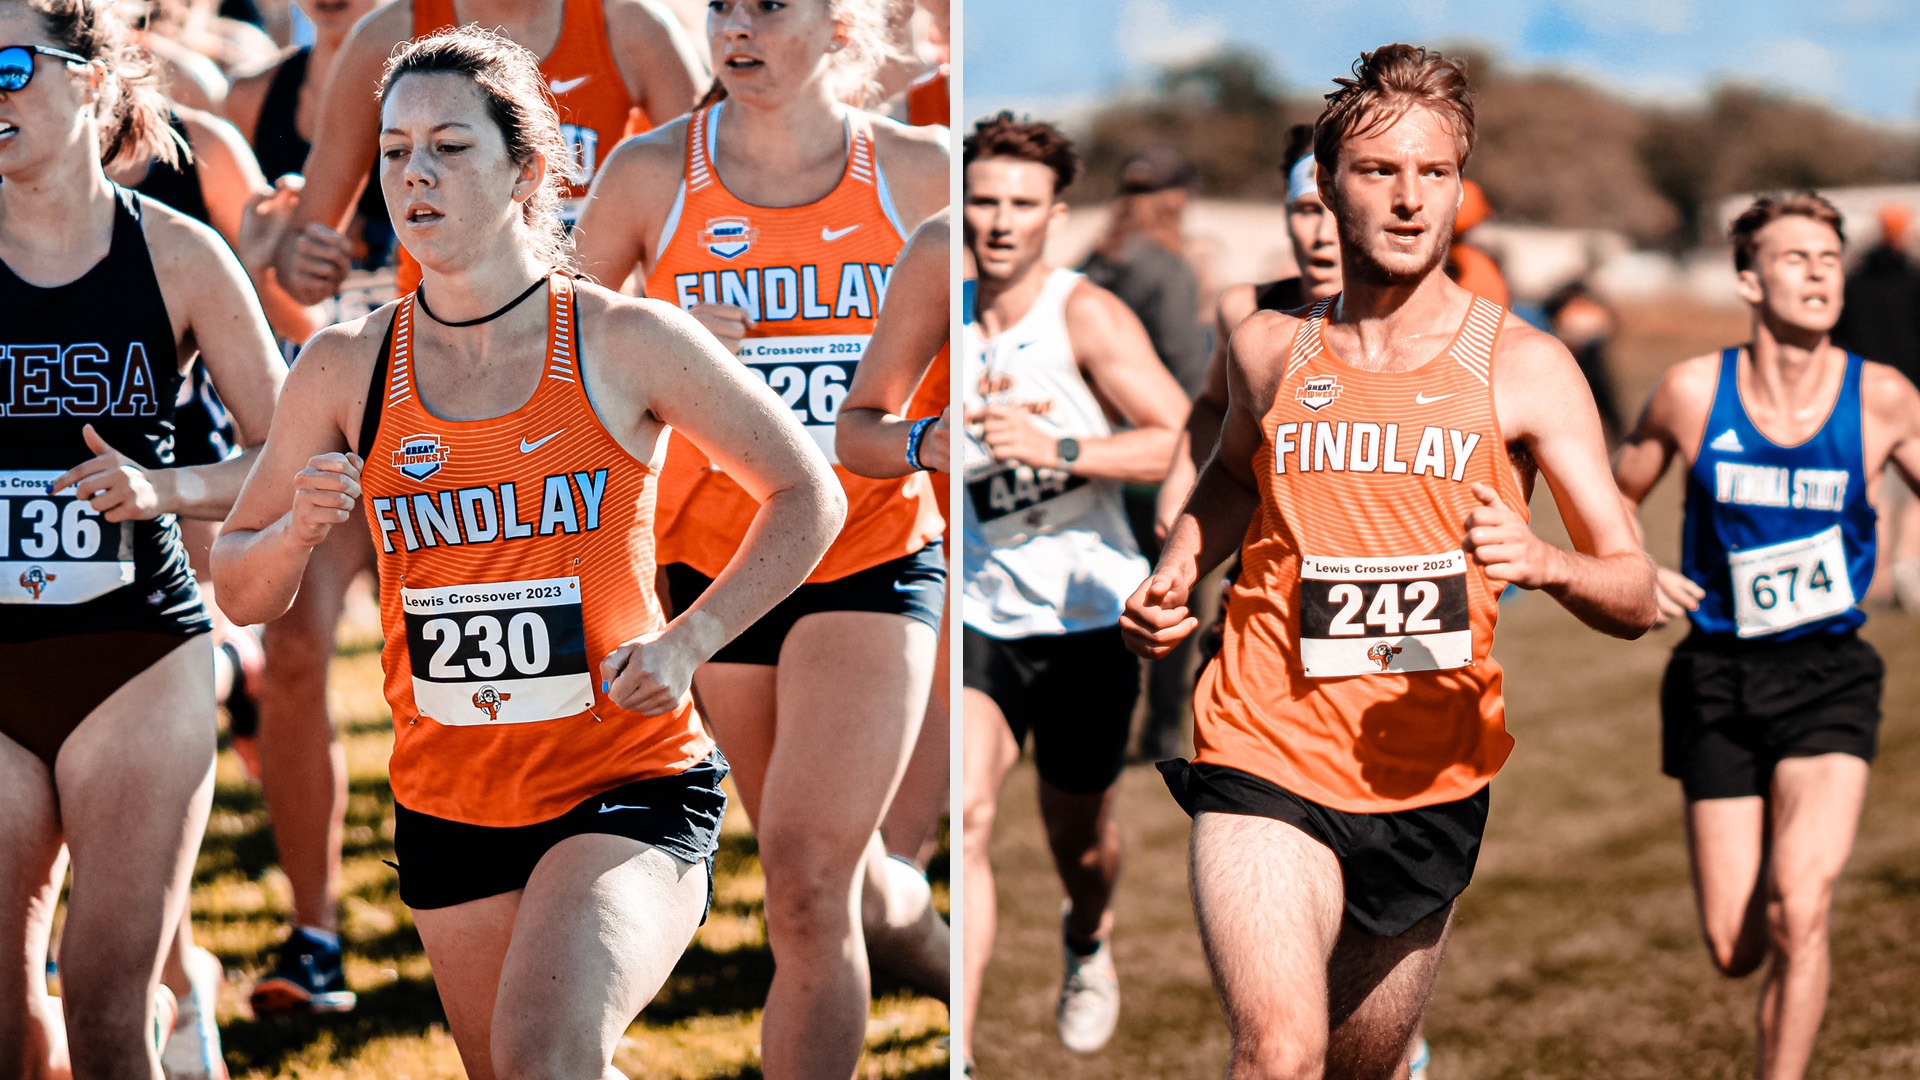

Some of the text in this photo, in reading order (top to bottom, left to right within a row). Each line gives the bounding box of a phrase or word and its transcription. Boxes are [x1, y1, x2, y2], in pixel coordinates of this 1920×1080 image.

[757, 345, 825, 356] Crossover
[829, 343, 861, 353] 2023
[0, 342, 158, 416] ESA
[745, 363, 848, 424] 26
[393, 447, 449, 466] MIDWEST
[405, 444, 436, 456] GREAT
[1275, 420, 1482, 482] FINDLAY
[372, 467, 609, 554] FINDLAY
[1315, 558, 1453, 574] Lewis Crossover 2023
[1751, 559, 1834, 610] 674
[405, 586, 562, 607] Lewis Crossover 2023
[1328, 580, 1441, 636] 242
[422, 611, 551, 679] 230
